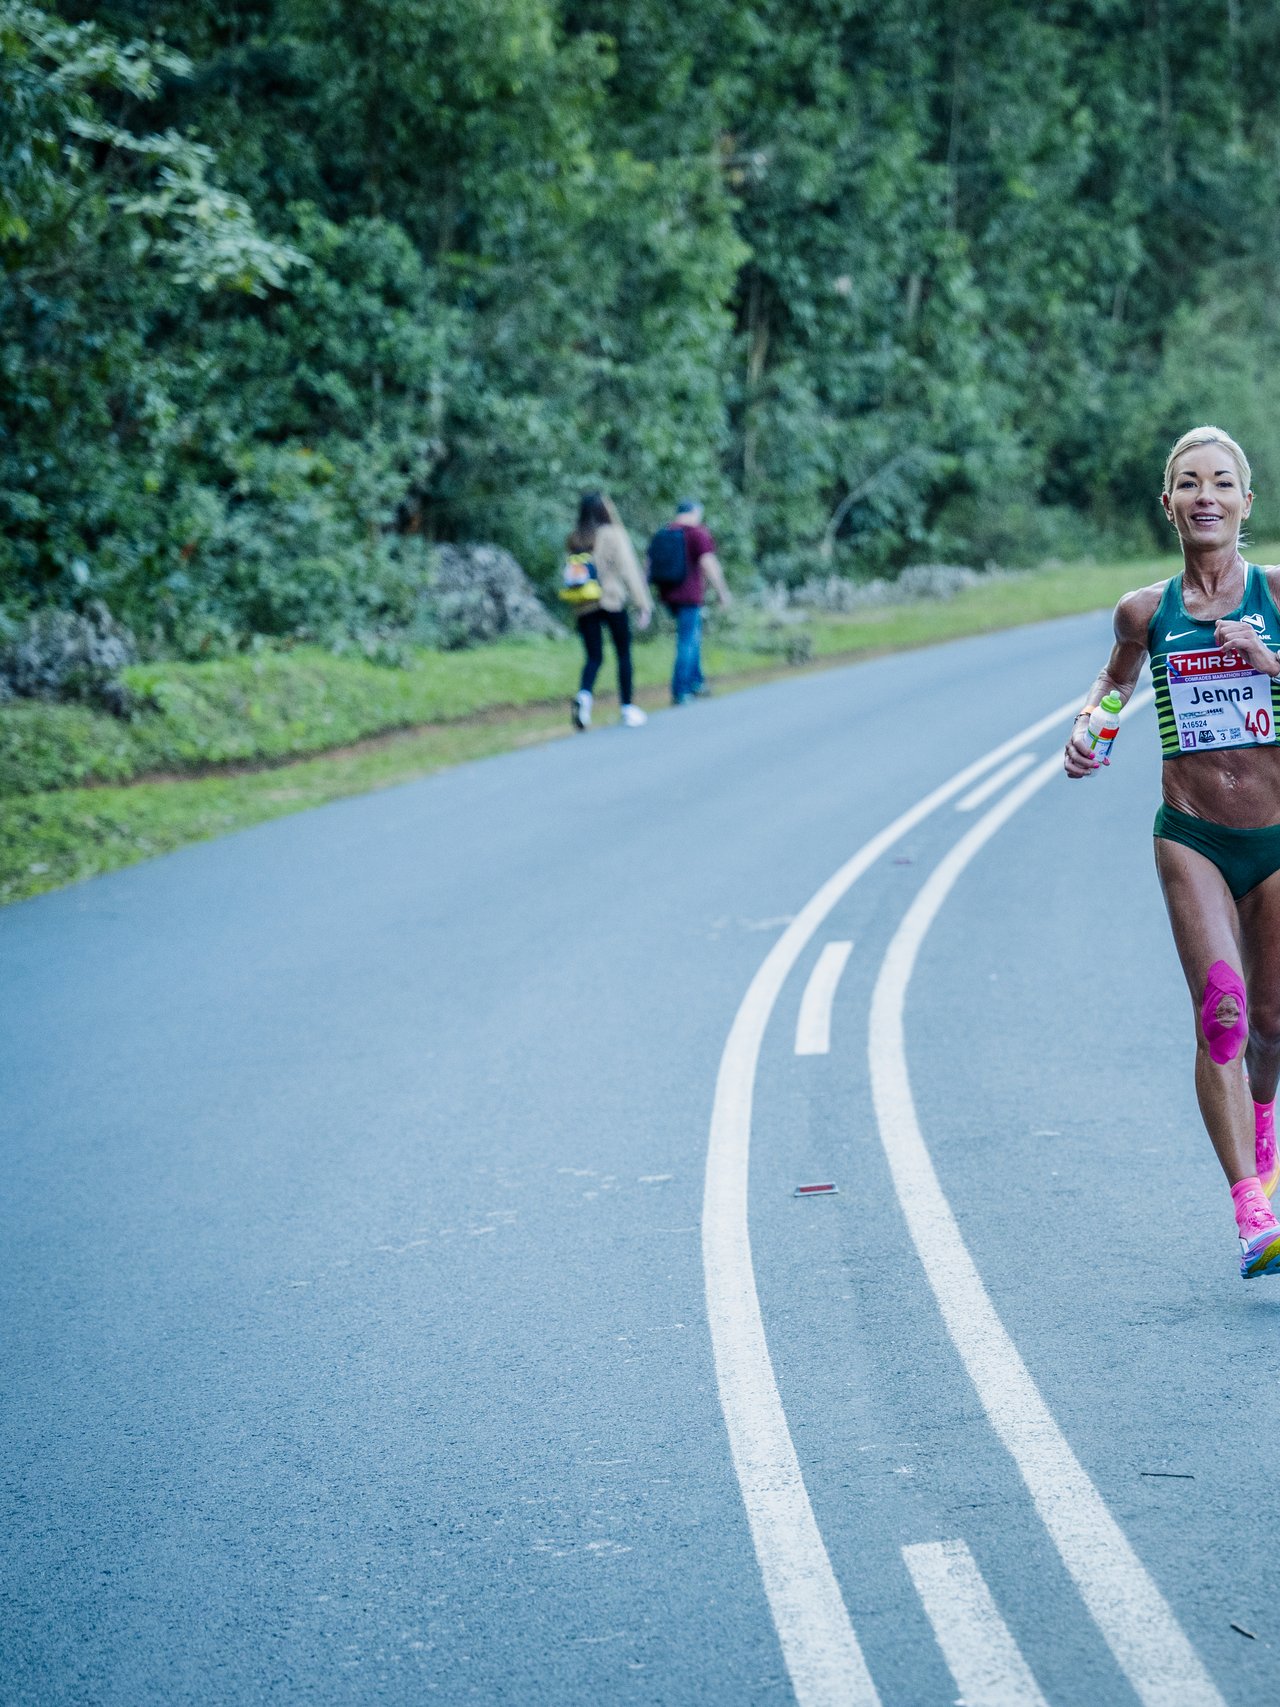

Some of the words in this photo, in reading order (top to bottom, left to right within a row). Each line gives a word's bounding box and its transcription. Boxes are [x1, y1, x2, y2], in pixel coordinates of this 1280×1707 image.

[1174, 654, 1248, 672] THIRST
[1184, 675, 1212, 683] COMRADES
[1190, 686, 1253, 705] Jenna
[1182, 720, 1207, 729] A16524
[1245, 708, 1270, 737] 40
[1200, 731, 1212, 739] ASA
[1220, 733, 1226, 741] 3
